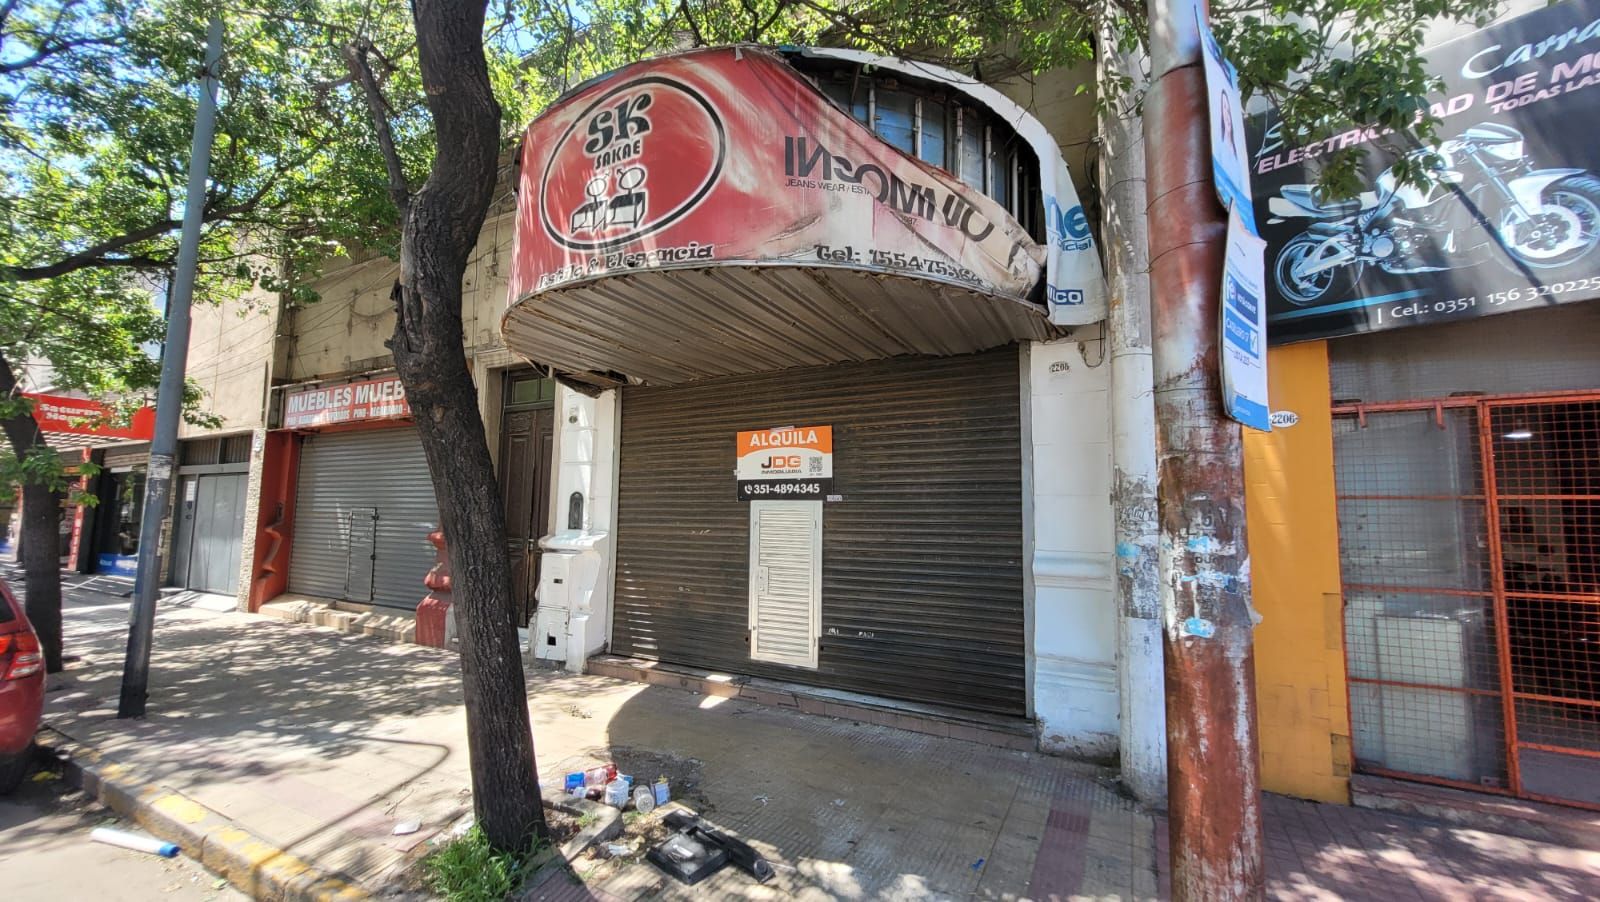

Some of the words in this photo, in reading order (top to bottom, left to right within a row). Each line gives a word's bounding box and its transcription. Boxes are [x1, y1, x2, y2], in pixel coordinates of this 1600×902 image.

[1491, 84, 1561, 114] TODAS
[585, 93, 652, 153] SK
[1258, 93, 1474, 174] ELECTRIAD
[1485, 71, 1539, 104] DE
[595, 139, 642, 170] SAKAE
[785, 179, 816, 188] JEANS
[818, 182, 846, 192] WEAR
[605, 243, 713, 269] Elegncia
[1391, 303, 1429, 319] Cel.:
[1434, 296, 1476, 313] 0351
[1487, 287, 1521, 306] 156
[288, 386, 352, 413] MUEBLES
[355, 380, 405, 404] MUEB
[1271, 414, 1295, 424] 2206
[750, 430, 818, 447] ALQUILA
[761, 455, 801, 469] JDG
[753, 483, 820, 494] 351-4894345
